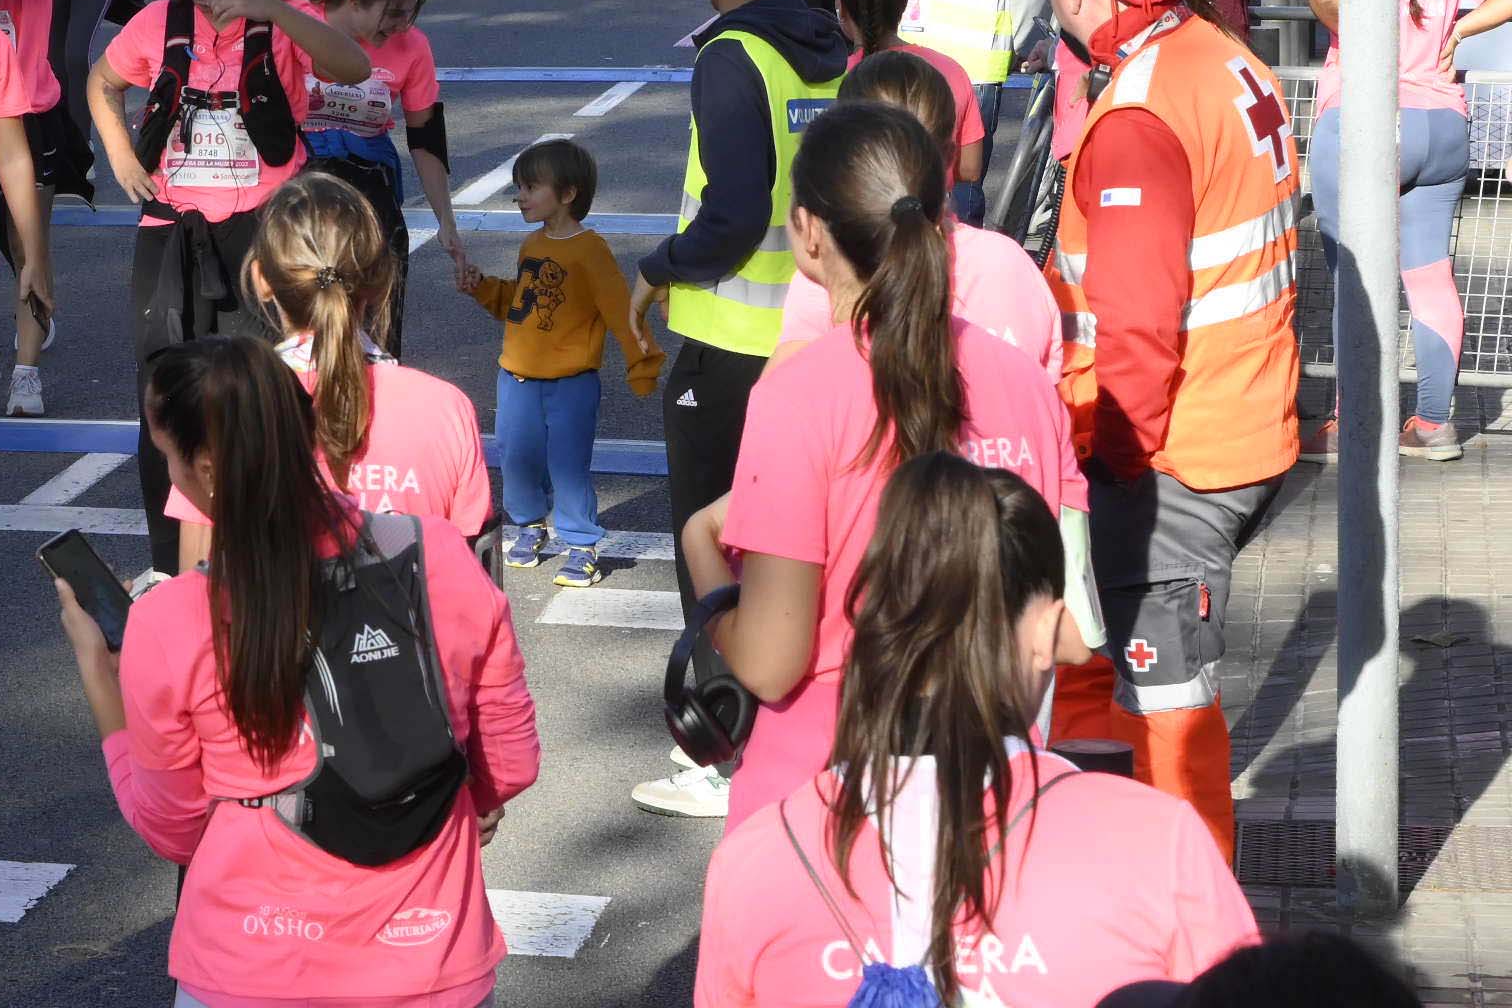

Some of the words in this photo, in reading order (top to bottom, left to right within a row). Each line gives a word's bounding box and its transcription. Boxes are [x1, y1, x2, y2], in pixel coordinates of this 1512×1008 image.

[193, 133, 226, 145] 016
[676, 398, 698, 408] adidas
[350, 645, 401, 665] AONIJIE
[243, 914, 325, 941] OYSHO
[821, 934, 1048, 981] CAERA
